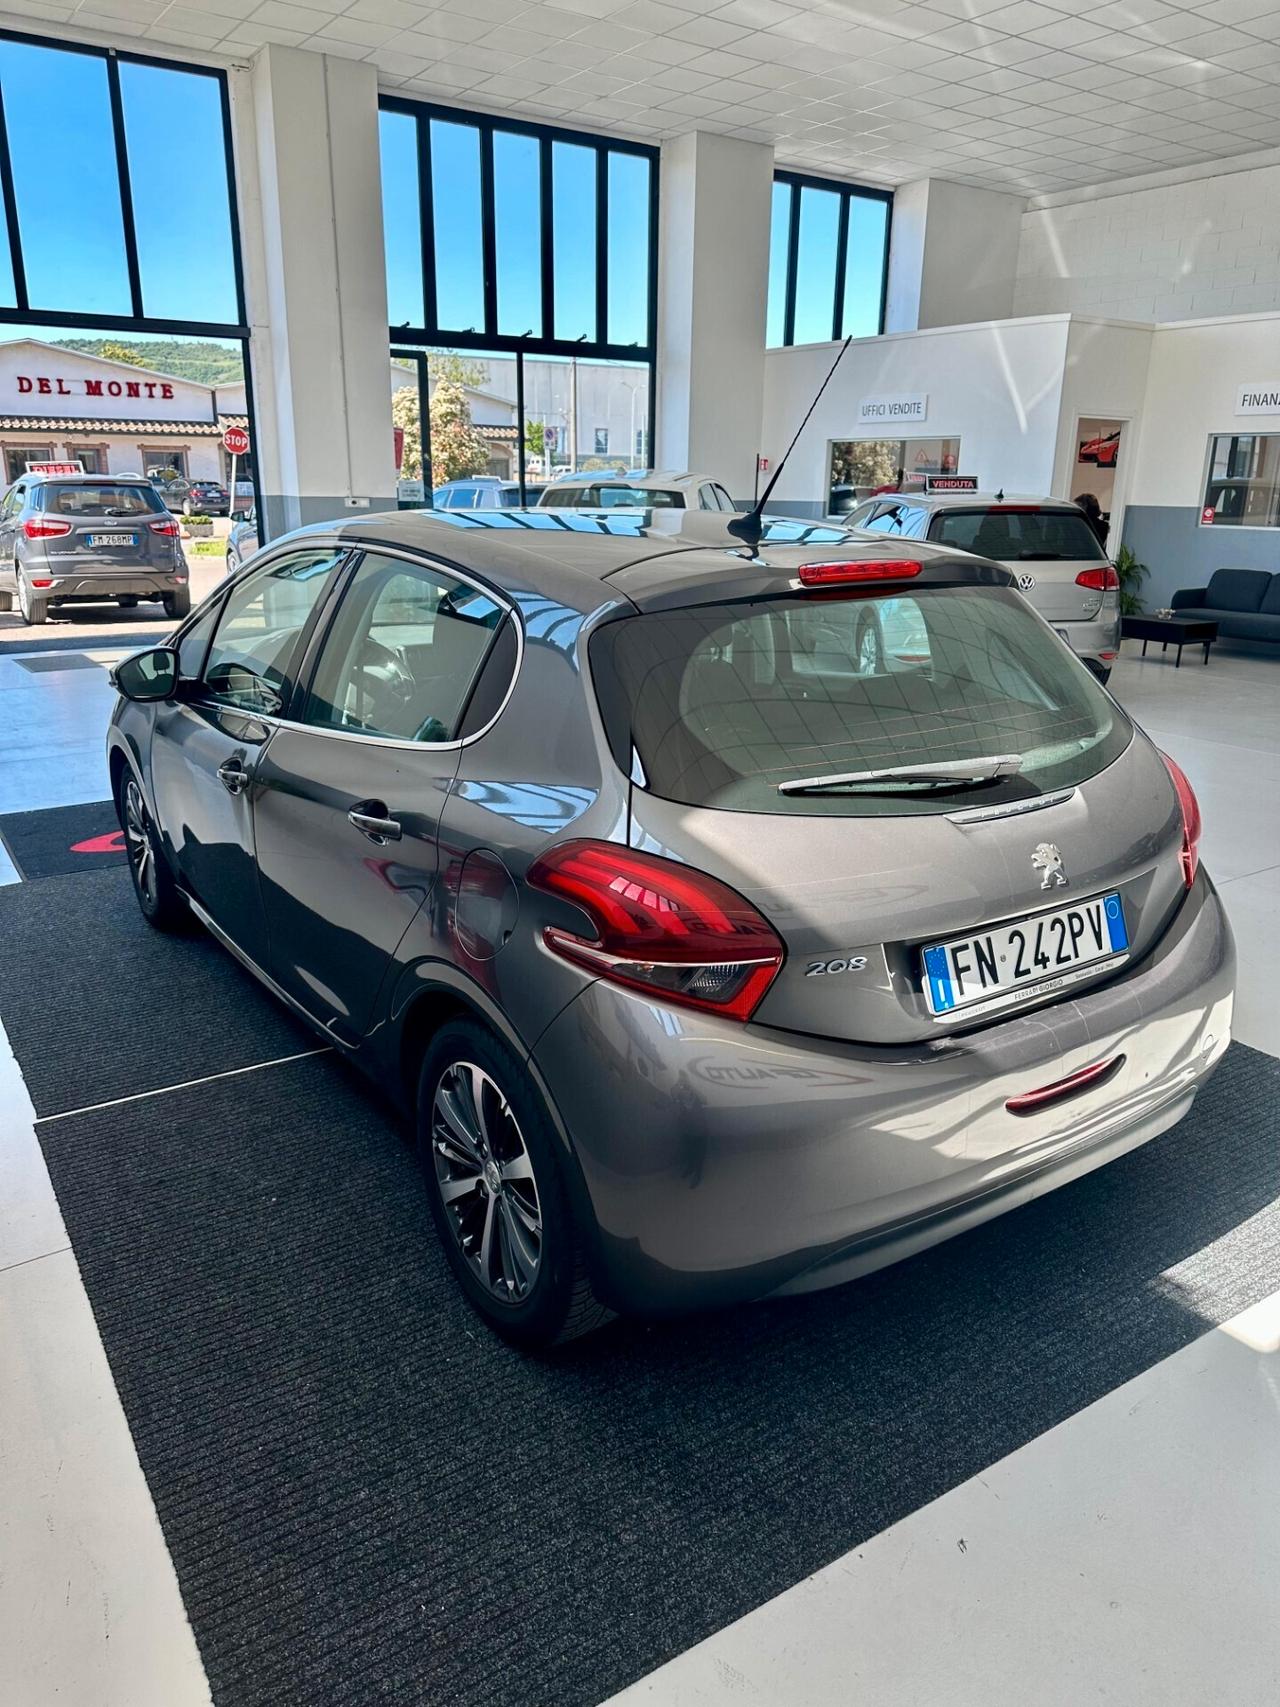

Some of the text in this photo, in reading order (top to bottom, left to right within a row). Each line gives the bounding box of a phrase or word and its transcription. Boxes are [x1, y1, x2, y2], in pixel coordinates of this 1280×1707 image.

[17, 376, 174, 400] DEL MONTE
[1241, 392, 1280, 407] FINAN
[862, 402, 922, 417] UFFICI VENDITE
[225, 434, 248, 448] STOP
[932, 480, 974, 488] VENDUTA
[805, 955, 869, 977] 208
